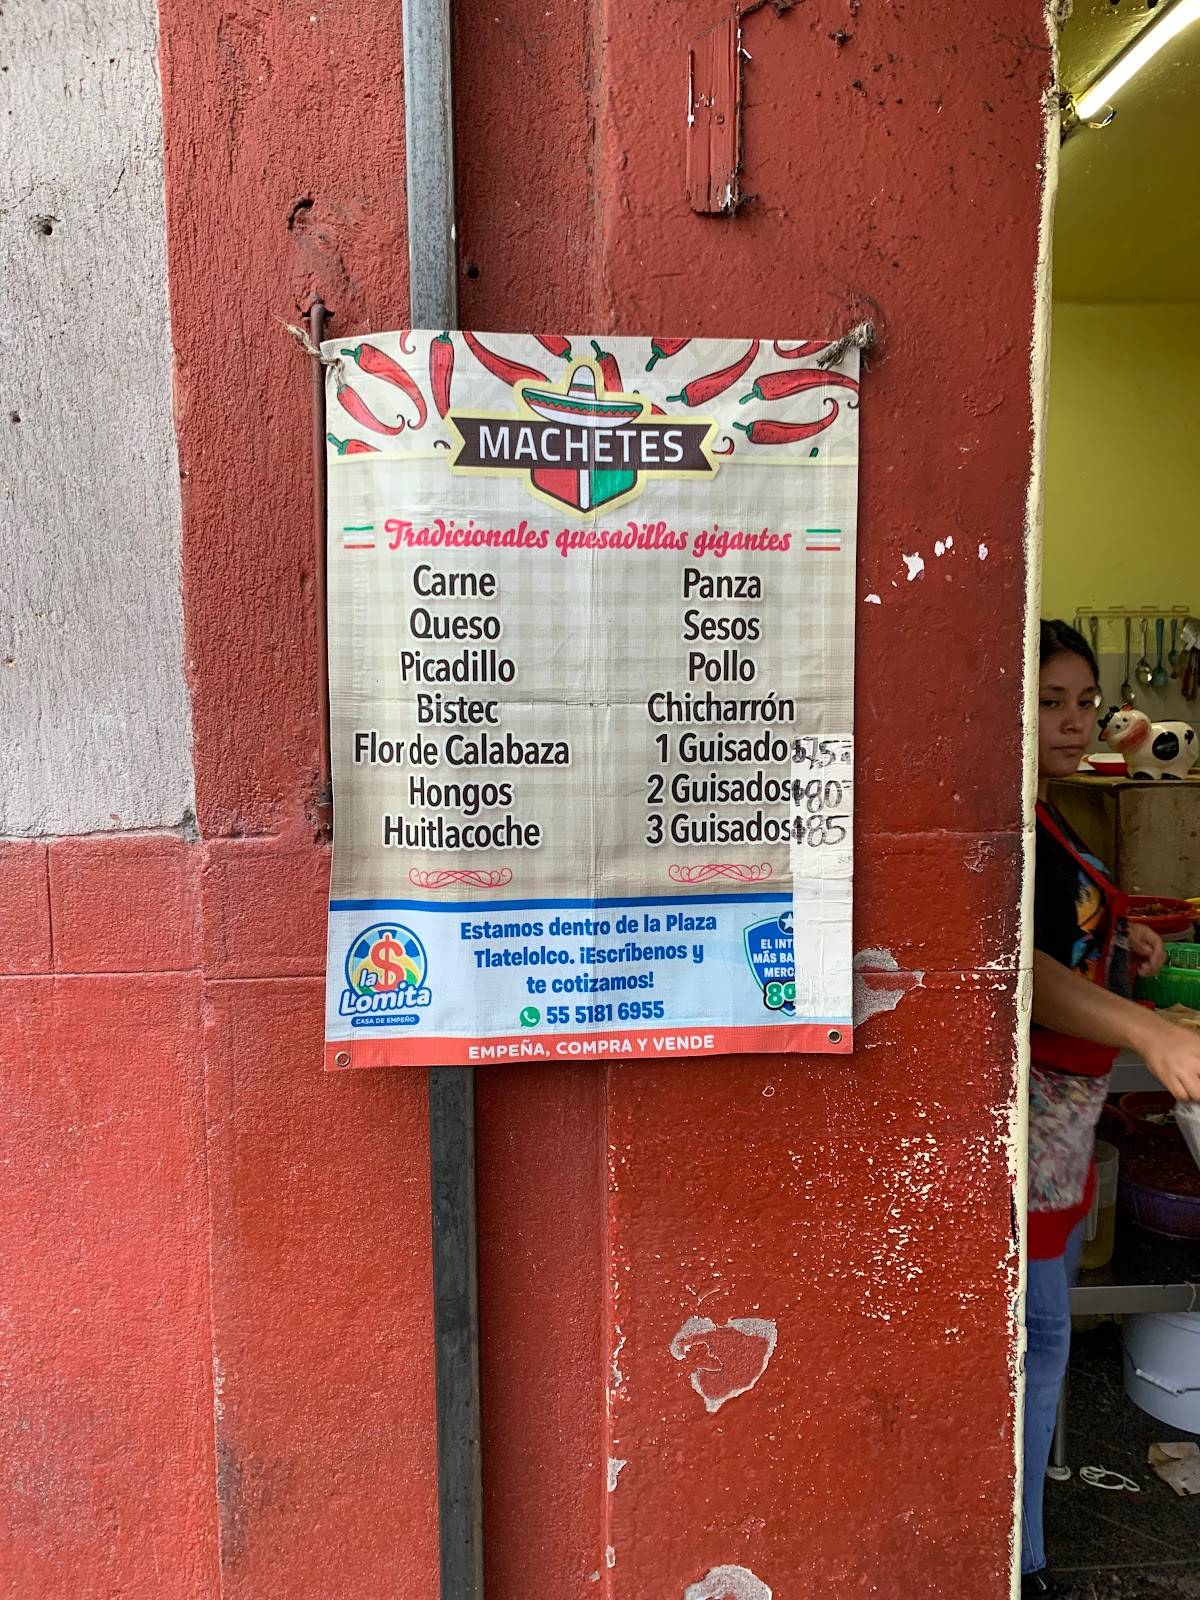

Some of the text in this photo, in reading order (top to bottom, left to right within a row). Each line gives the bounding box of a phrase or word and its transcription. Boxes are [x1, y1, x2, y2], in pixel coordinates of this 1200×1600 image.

[478, 425, 684, 464] MACHETES
[384, 518, 793, 558] Tradicionales quesadillas gigantes
[413, 564, 496, 597] Carne
[683, 568, 762, 599] Panza
[410, 607, 501, 640] Queso
[683, 609, 761, 641] Sesos
[400, 649, 515, 682] Picadillo
[688, 650, 756, 682] Pollo
[416, 693, 499, 724] Bistec
[648, 691, 795, 723] Chicharrón
[355, 731, 569, 765] Flor de Calabaza
[655, 731, 788, 764] 1 Guisado
[409, 775, 513, 816] Hongos
[647, 770, 791, 804] 2 Guisados
[384, 815, 541, 848] Huitlacoche
[646, 811, 790, 844] 3 Guisados
[460, 912, 718, 940] Estamos dentro de la Plaza
[474, 946, 575, 968] Tlatelolco.
[692, 944, 705, 964] y
[753, 950, 795, 964] MÁS BA
[760, 938, 793, 950] EL INT
[359, 968, 379, 987] la
[526, 971, 655, 994] te cotizamos!
[764, 967, 795, 978] MERC
[339, 981, 432, 1016] Lomita
[546, 1000, 665, 1025] 55 5181 6955
[355, 1014, 416, 1026] CASA DE EMPEÑO
[468, 1034, 716, 1060] EMPEÑA, COMPRA Y VENDE
